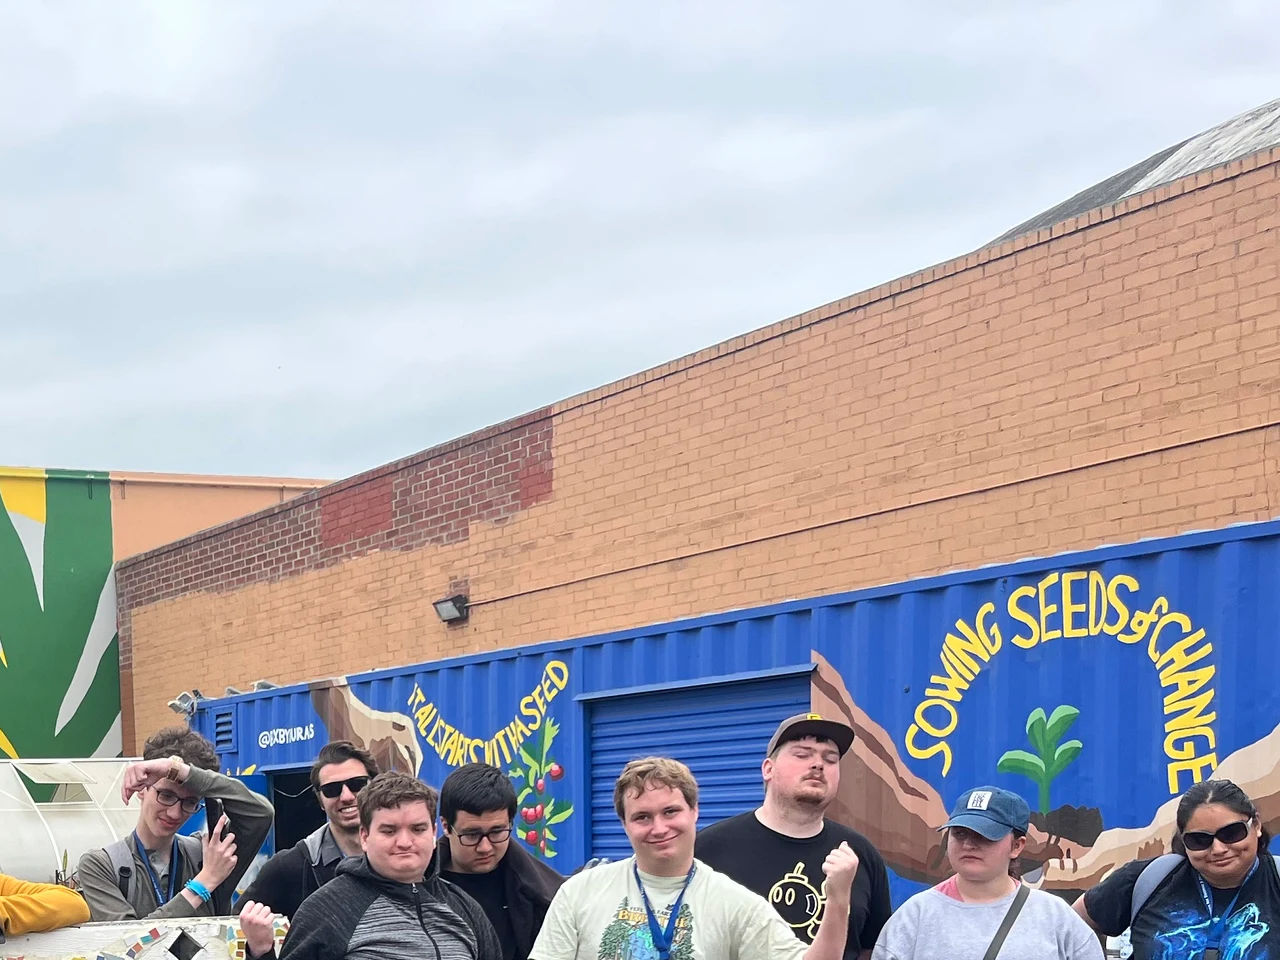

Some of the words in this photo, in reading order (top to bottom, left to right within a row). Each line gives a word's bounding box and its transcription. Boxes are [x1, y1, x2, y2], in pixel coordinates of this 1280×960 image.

[407, 682, 426, 713] IT
[519, 660, 569, 732] SEED
[905, 601, 1002, 778] SOWING
[1007, 570, 1140, 650] SEEDS
[1147, 611, 1219, 795] CHANGE
[414, 702, 442, 748] ALL
[434, 718, 485, 768] STARTS
[514, 714, 532, 744] A
